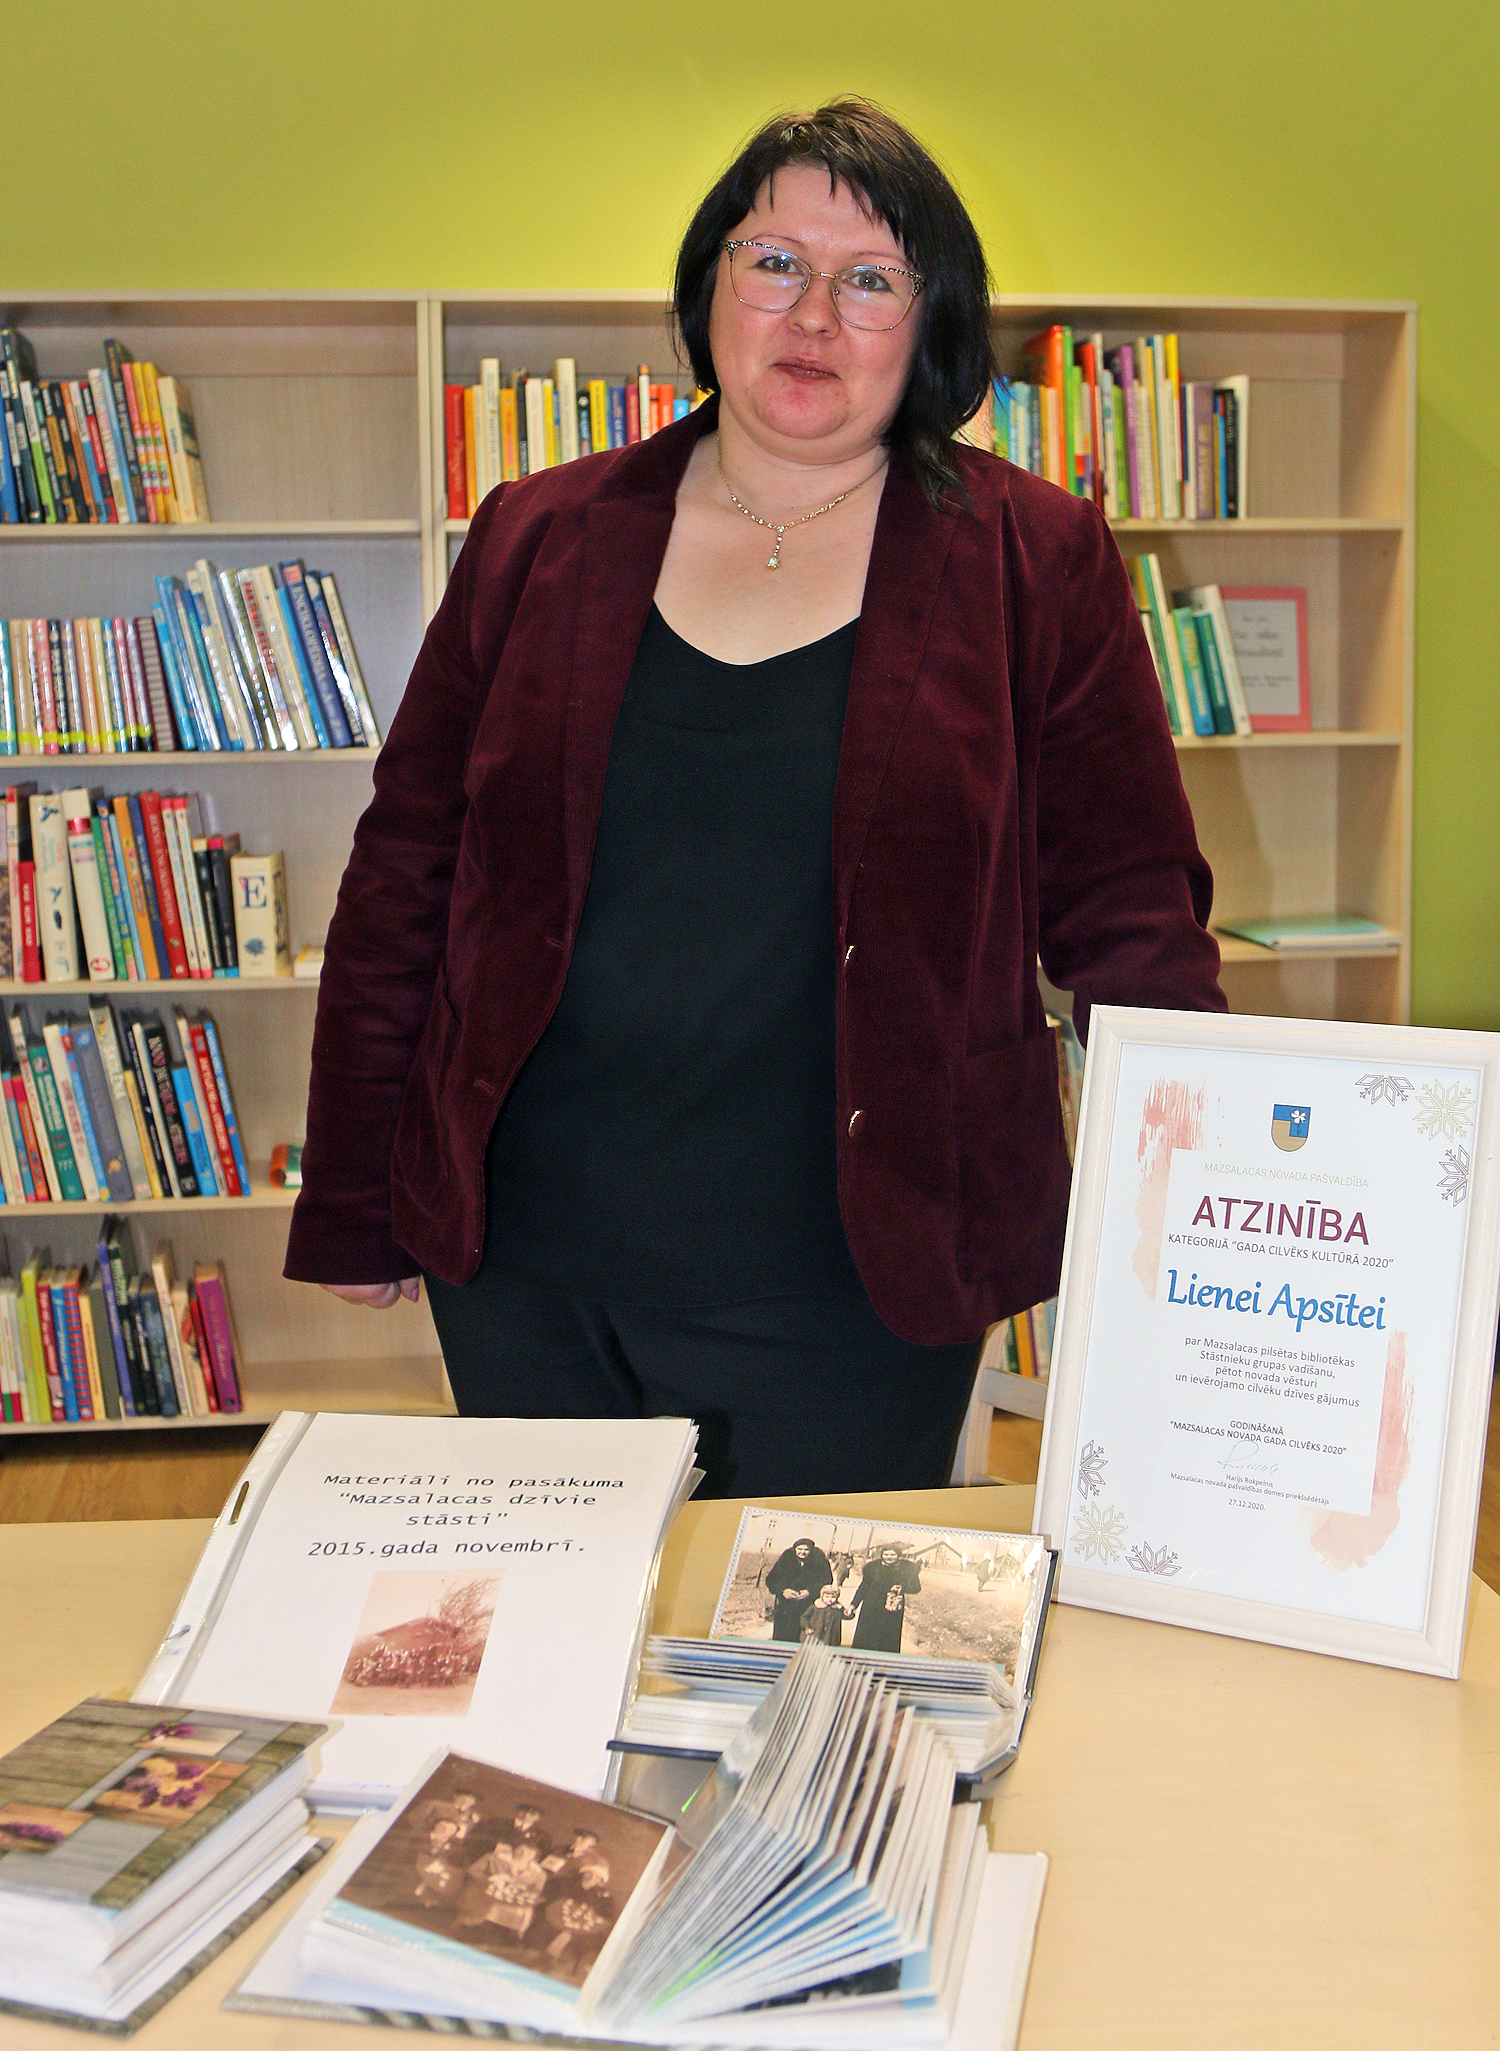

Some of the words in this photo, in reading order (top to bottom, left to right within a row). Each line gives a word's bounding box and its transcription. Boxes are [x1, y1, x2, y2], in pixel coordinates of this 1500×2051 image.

[239, 875, 267, 909] E
[1204, 1163, 1267, 1178] MAZSALACAS
[1269, 1170, 1308, 1182] NOVADA
[1310, 1173, 1369, 1188] PAŠVALDĪBA
[1192, 1195, 1370, 1246] ATZINĪBA
[1168, 1233, 1229, 1250] KATEGORIJĀ
[1268, 1245, 1309, 1259] CILVĒKS
[1311, 1250, 1360, 1265] KULTŪRĀ
[1167, 1269, 1262, 1314] Lienei
[1267, 1283, 1387, 1332] Apsītei
[1185, 1336, 1202, 1347] par
[1203, 1338, 1258, 1355] Mazsalacas
[1260, 1346, 1298, 1361] pilsētas
[1301, 1351, 1356, 1368] bibliotēkas
[1199, 1350, 1251, 1367] Stāstnieku
[1252, 1359, 1286, 1372] grupas
[1288, 1364, 1336, 1380] vadīšanu,
[1215, 1365, 1242, 1378] pētot
[1244, 1369, 1281, 1383] novada
[1283, 1375, 1318, 1389] vēsturi
[1175, 1373, 1188, 1383] un
[1190, 1373, 1245, 1391] ievērojamo
[1247, 1381, 1281, 1396] cilvēku
[1283, 1386, 1315, 1401] dzīves
[1316, 1392, 1360, 1408] gājumus
[1229, 1420, 1284, 1436] GODINĀŠANĀ
[1226, 1430, 1262, 1443] NOVADA
[1263, 1436, 1287, 1447] GADA
[1288, 1439, 1321, 1452] CILVĒKS
[323, 1475, 450, 1487] Materiāli
[466, 1477, 495, 1487] no
[508, 1477, 625, 1489] pasākuma
[1170, 1472, 1204, 1484] Mazsalacas
[1204, 1479, 1227, 1488] novada
[1263, 1488, 1285, 1498] domes
[1225, 1474, 1243, 1484] Harijs
[1244, 1477, 1274, 1488] Rokpelnis
[508, 1494, 597, 1506] dzīvie
[1228, 1498, 1266, 1511] 27.12.2020.
[307, 1539, 439, 1558] 2015.gada
[454, 1538, 586, 1554] novembrī.
